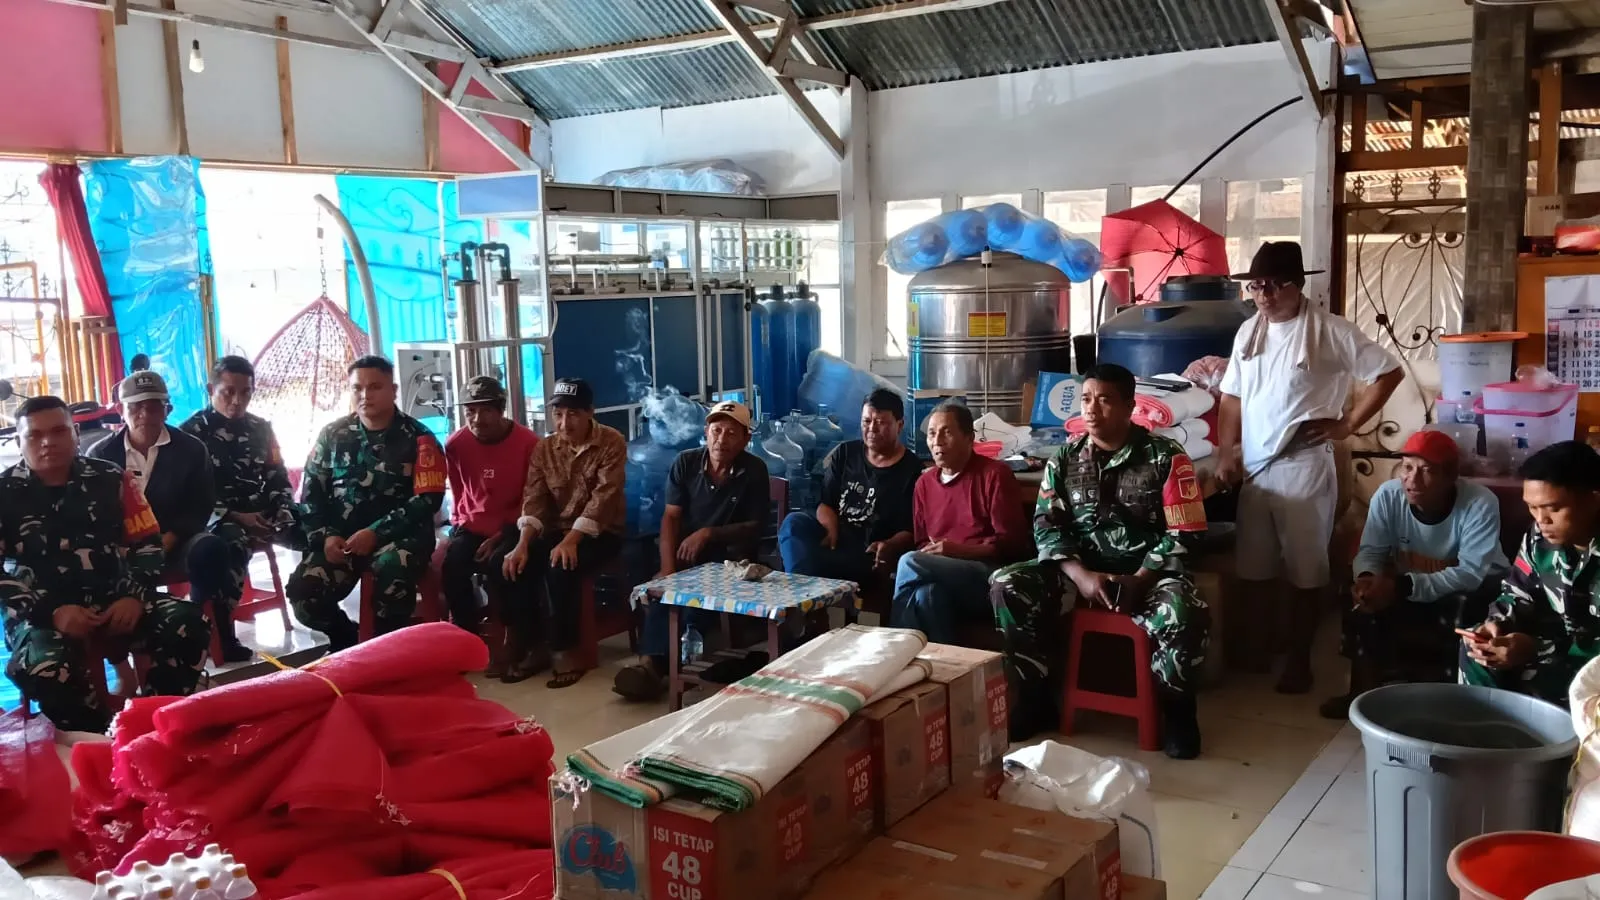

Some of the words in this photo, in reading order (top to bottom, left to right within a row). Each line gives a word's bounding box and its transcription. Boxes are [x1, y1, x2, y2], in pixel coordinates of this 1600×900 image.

[1060, 385, 1075, 413] AQUA
[483, 469, 494, 478] 23
[992, 696, 1006, 713] 48
[929, 730, 944, 749] 48
[852, 771, 869, 793] 48
[854, 790, 869, 806] CUP
[653, 825, 669, 843] ISI
[673, 831, 714, 853] TETAP
[783, 822, 802, 846] 48
[569, 831, 627, 874] Club
[662, 851, 702, 885] 48
[667, 882, 703, 900] CUP
